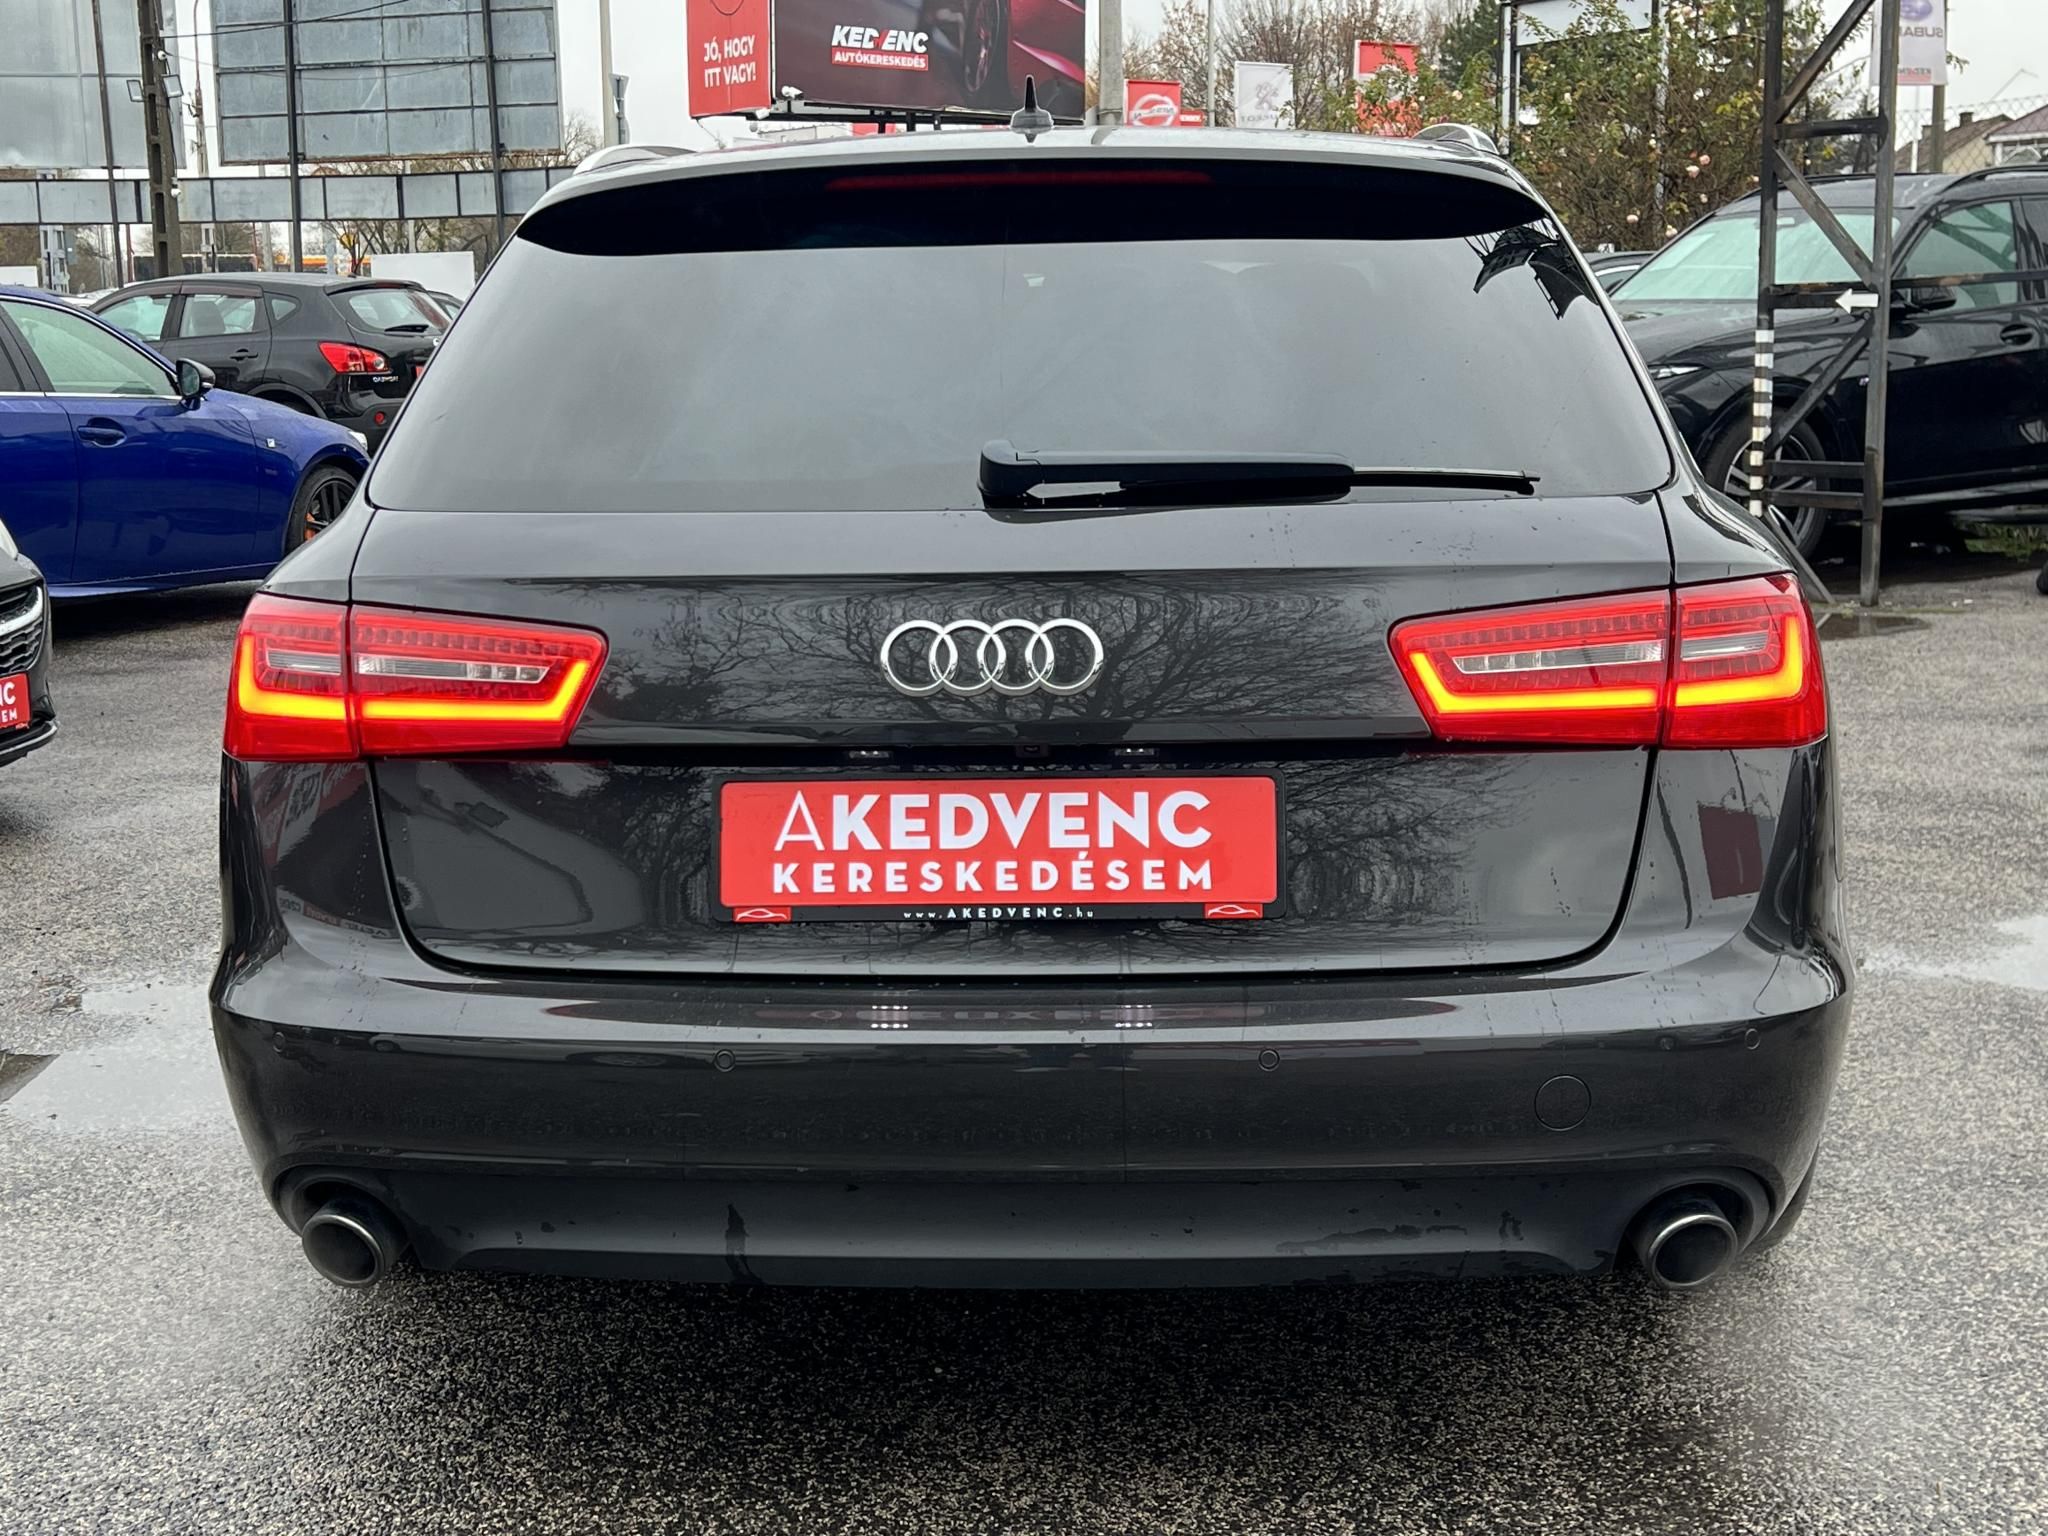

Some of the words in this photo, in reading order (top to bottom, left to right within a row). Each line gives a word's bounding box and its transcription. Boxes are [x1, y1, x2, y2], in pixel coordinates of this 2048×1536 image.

[704, 36, 722, 63] JÓ,
[724, 35, 755, 59] HOGY
[834, 51, 926, 69] AUTÓKERESKEDÉS
[704, 67, 721, 89] ITT
[723, 61, 757, 85] VAGY!
[0, 708, 17, 722] EM
[773, 852, 1212, 894] KERESKEDÉSEM
[903, 907, 1094, 919] www.AKEDVENC.hu
